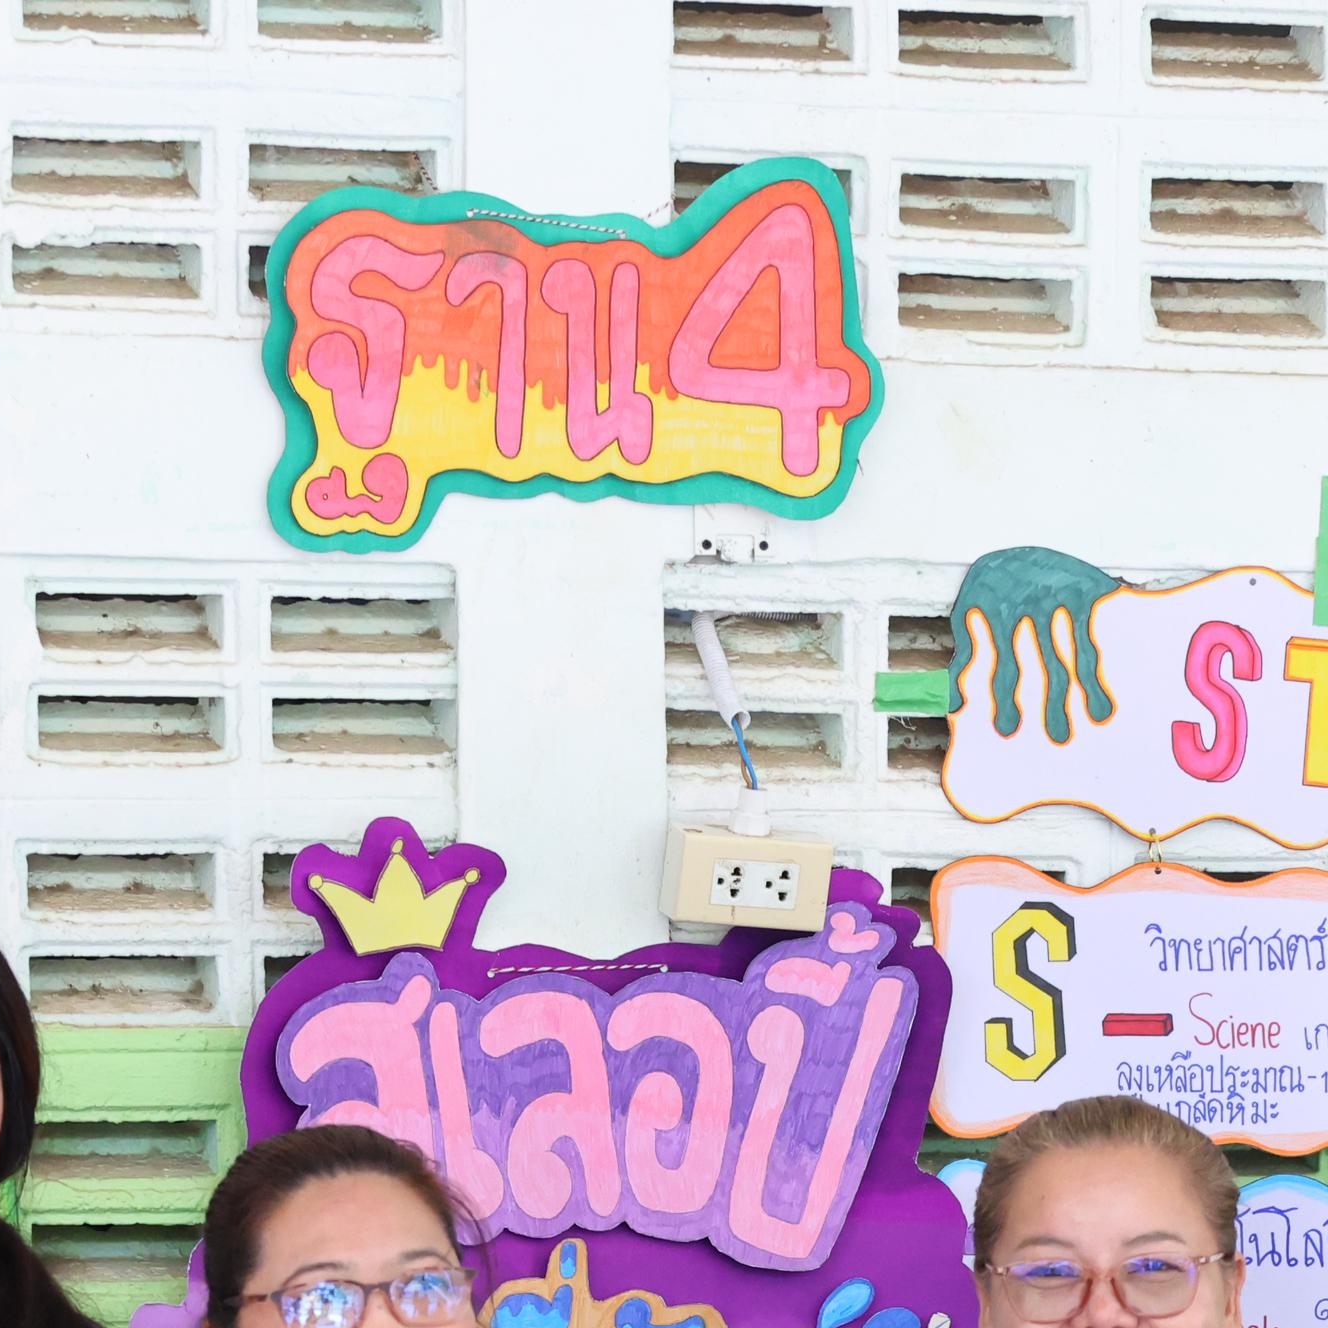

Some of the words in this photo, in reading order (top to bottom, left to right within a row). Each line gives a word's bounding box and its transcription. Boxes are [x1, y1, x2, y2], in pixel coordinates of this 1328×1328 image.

[1144, 917, 1328, 972] วิทยาศาสตร์
[984, 900, 1077, 1082] S
[1188, 992, 1281, 1049] Sciene
